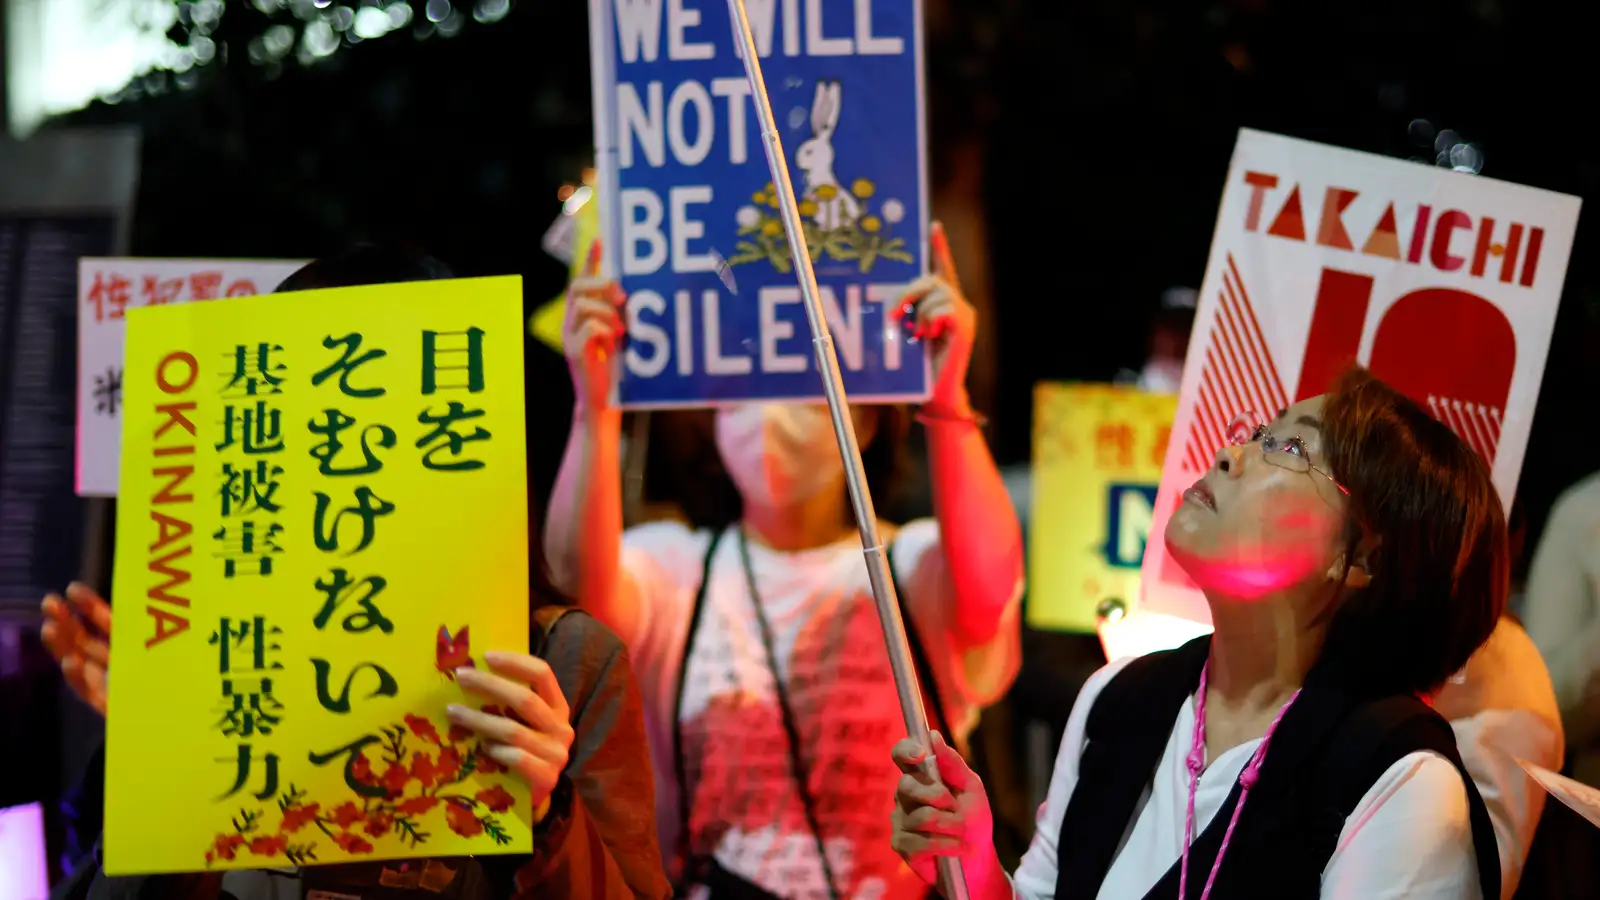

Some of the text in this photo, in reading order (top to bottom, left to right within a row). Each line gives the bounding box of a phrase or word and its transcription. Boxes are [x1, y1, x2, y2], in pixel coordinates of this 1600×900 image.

[613, 0, 904, 63] WE WILL
[616, 77, 755, 170] NOT
[620, 185, 714, 276] BE
[1243, 170, 1545, 289] TAKAICHI
[624, 283, 910, 378] SILENT
[414, 326, 492, 472] 目を
[144, 350, 199, 650] OKINAWA
[207, 342, 288, 803] 基地被害 性暴力
[307, 331, 398, 800] そむけないで
